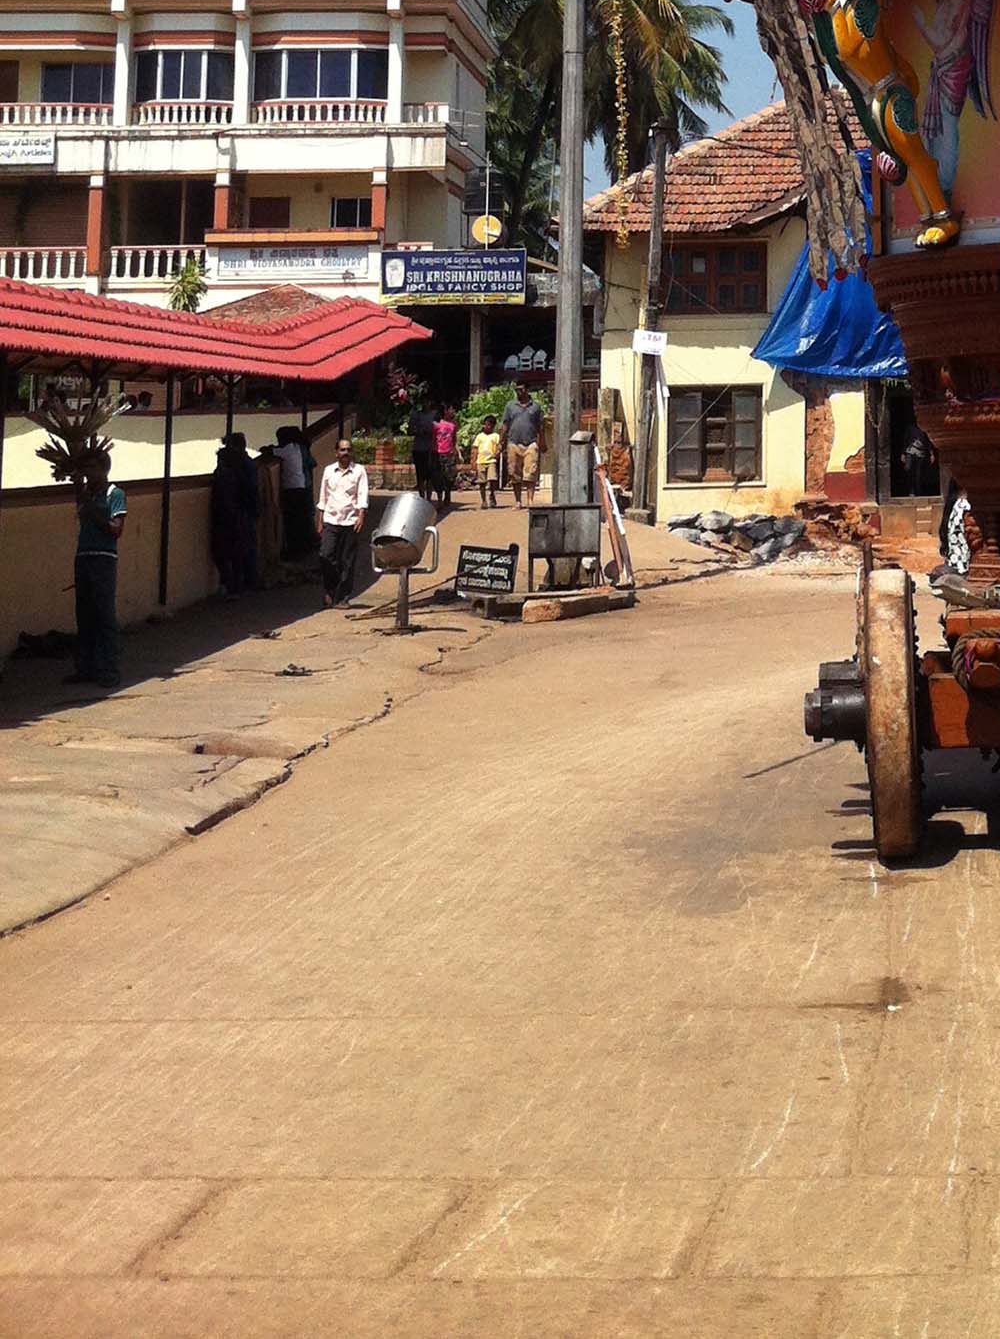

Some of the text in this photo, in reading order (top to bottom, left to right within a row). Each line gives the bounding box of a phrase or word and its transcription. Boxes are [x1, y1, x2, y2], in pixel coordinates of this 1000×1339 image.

[224, 260, 247, 269] SHRI
[406, 270, 522, 283] SRI KRISHNANUGRAHA
[406, 283, 523, 292] IDOL & FANCY SHOP
